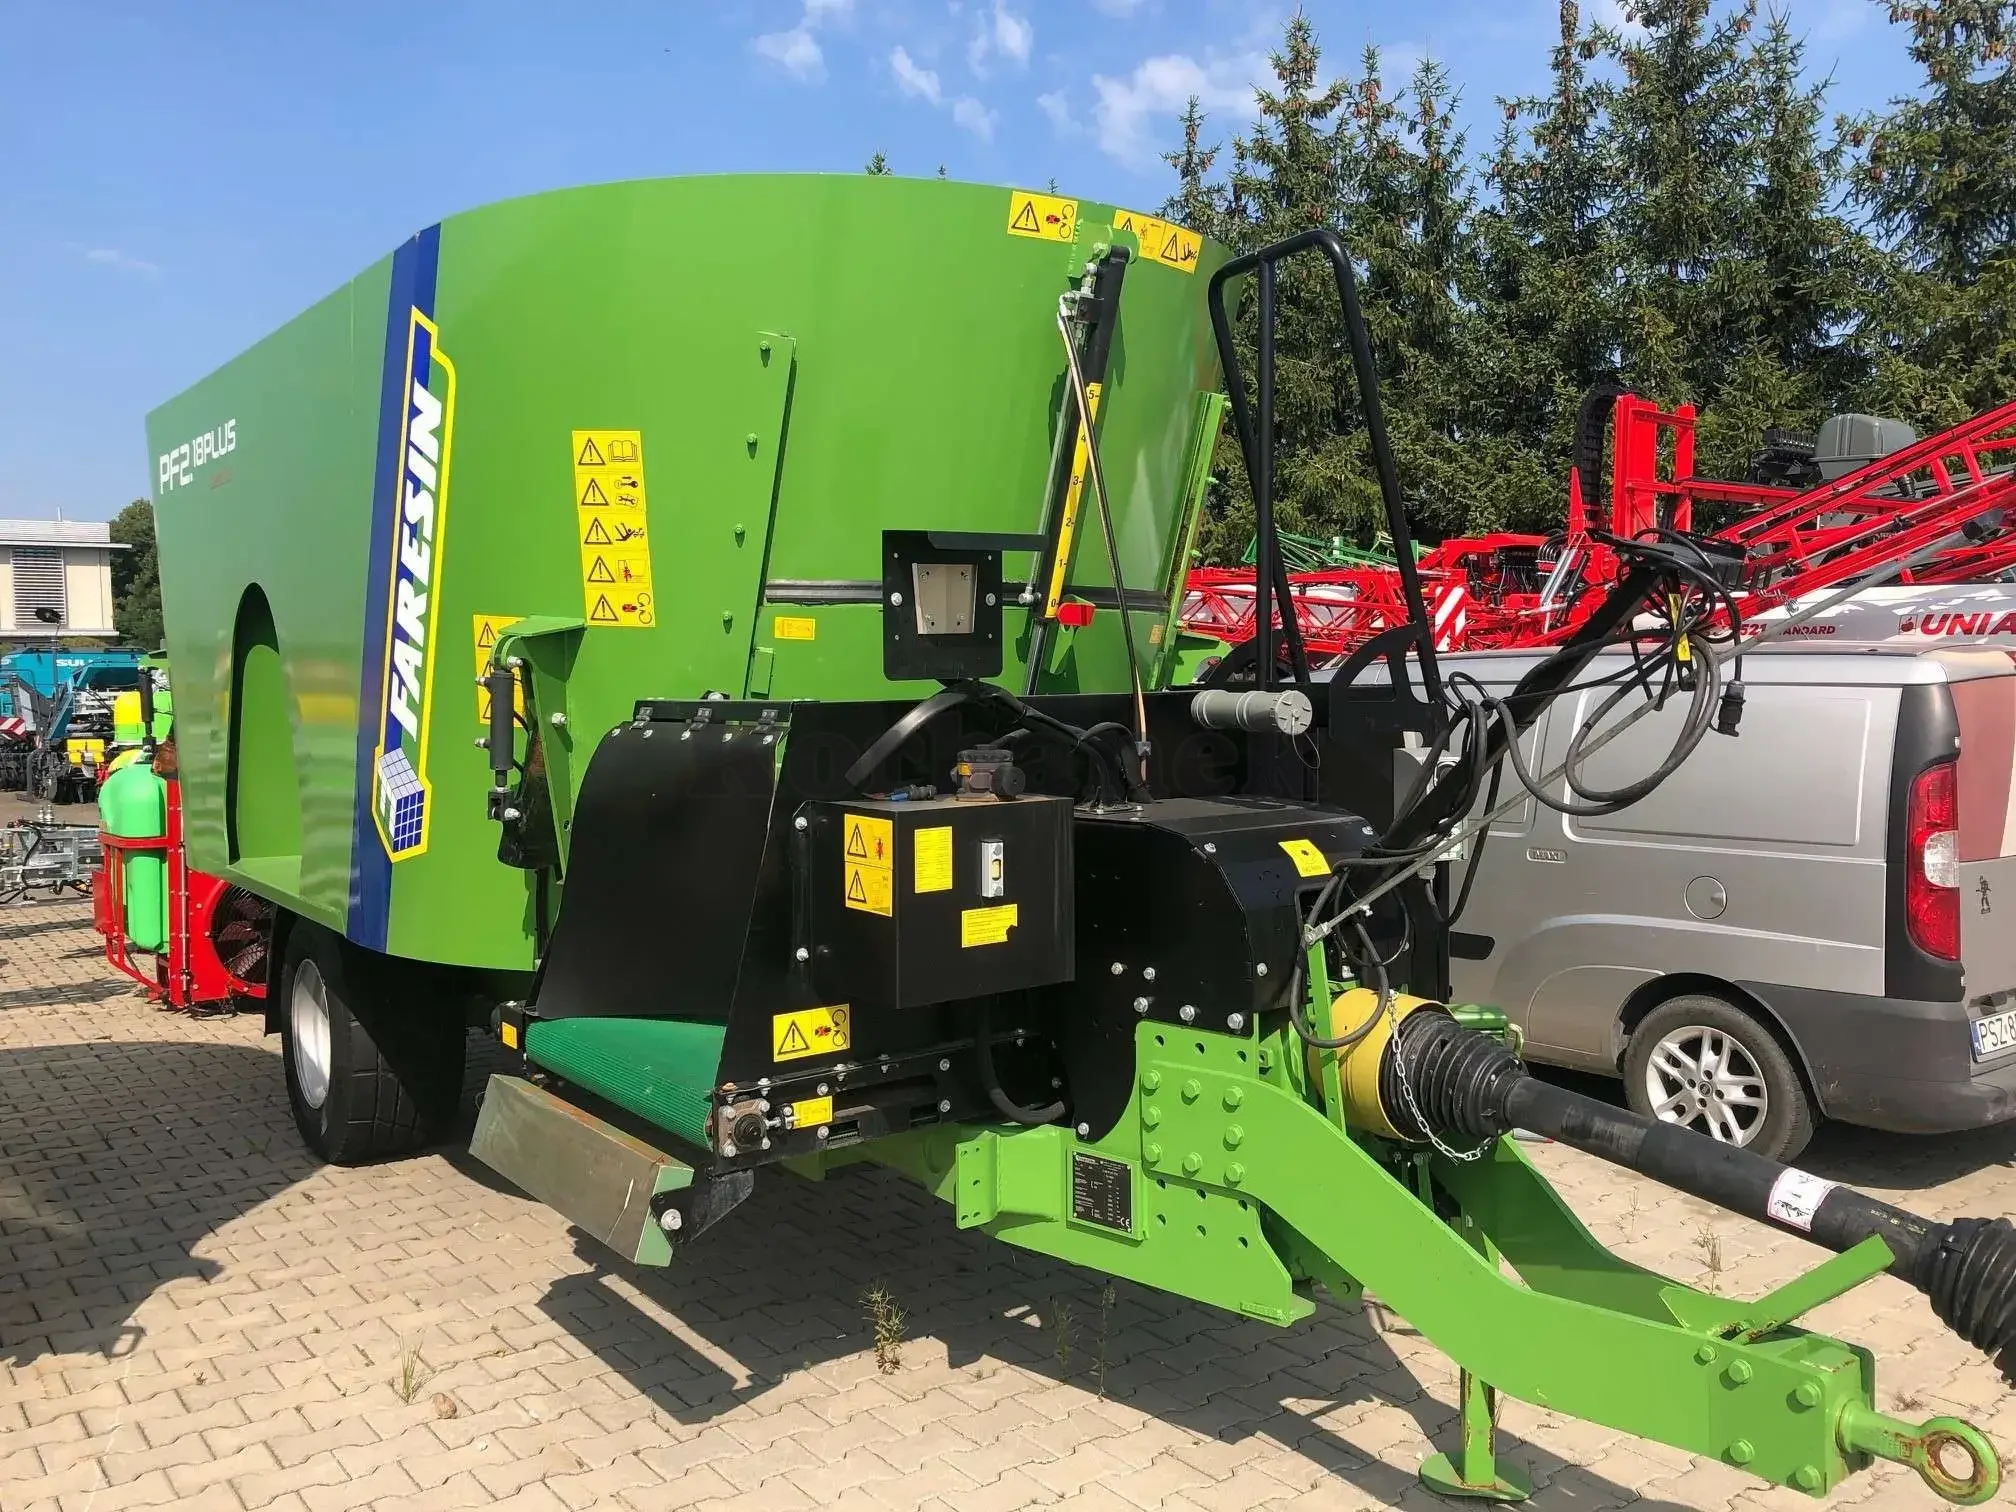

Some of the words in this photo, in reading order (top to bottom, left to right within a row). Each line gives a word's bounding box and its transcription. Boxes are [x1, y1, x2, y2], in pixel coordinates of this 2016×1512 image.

[389, 378, 442, 742] FARESIN
[1779, 625, 1836, 636] ANDARD
[1920, 612, 2016, 636] UNIA
[1978, 1018, 2007, 1050] PSZ
[2008, 1014, 2016, 1041] 8
